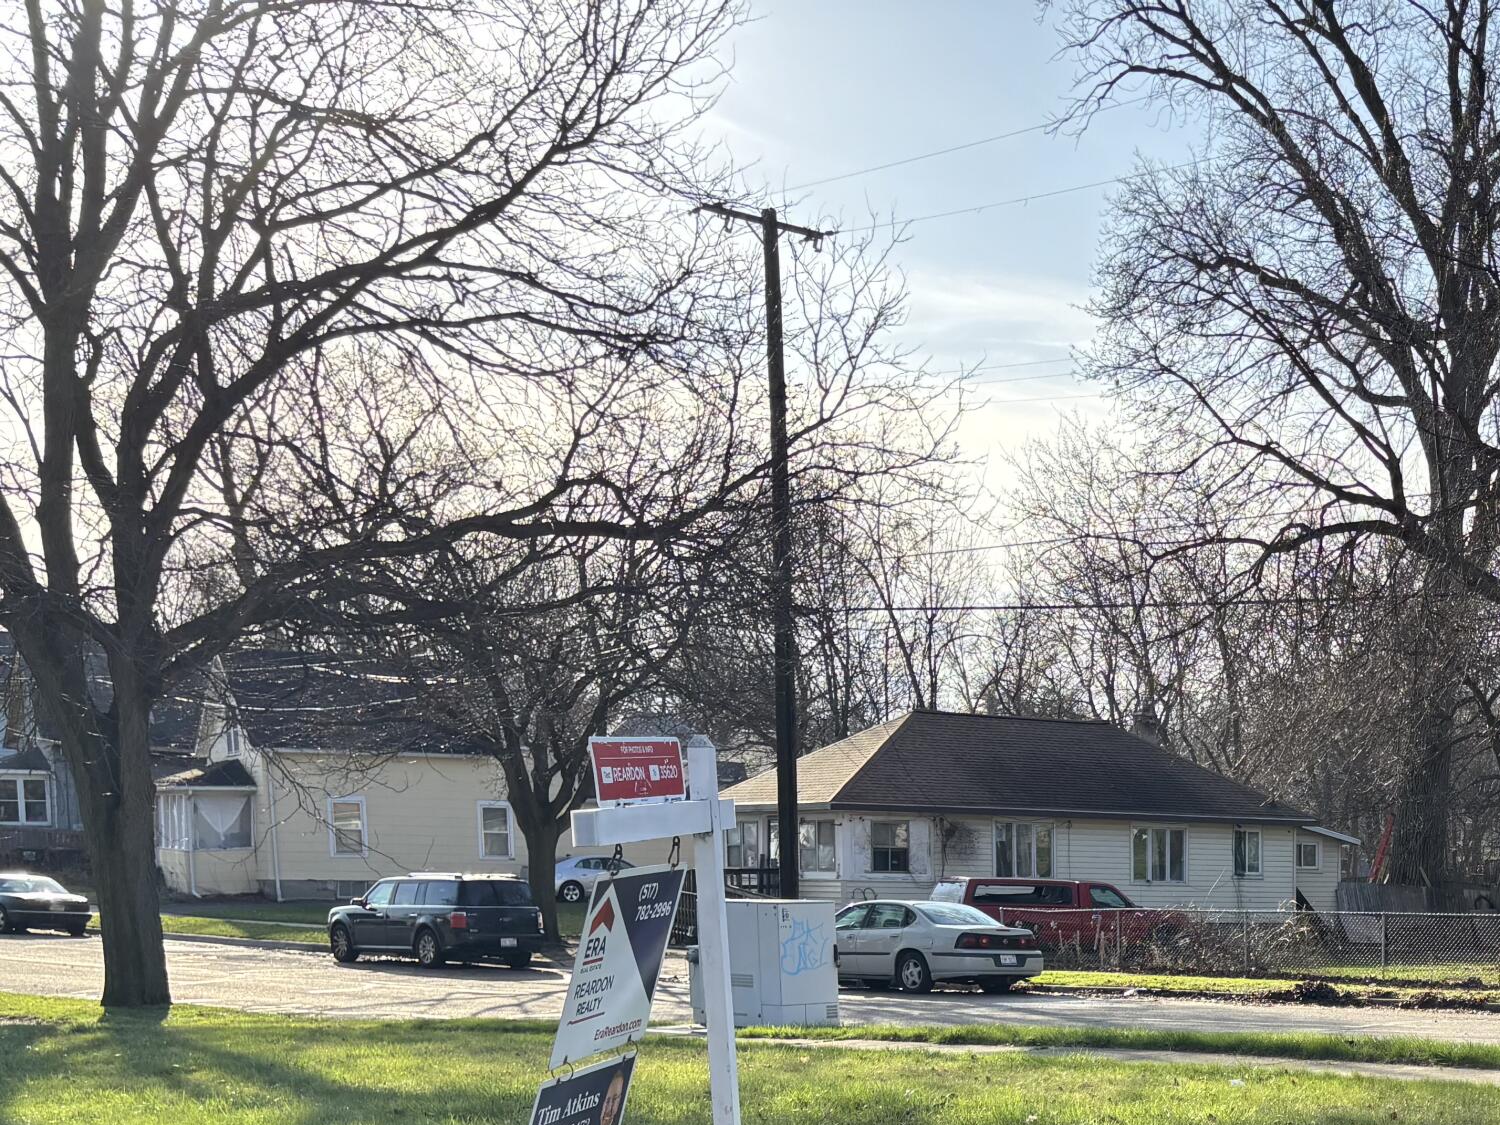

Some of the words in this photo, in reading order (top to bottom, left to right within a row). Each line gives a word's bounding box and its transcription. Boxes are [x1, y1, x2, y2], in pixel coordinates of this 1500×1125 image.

[613, 767, 646, 781] REARDON
[638, 882, 658, 902] (517)
[635, 901, 672, 921] 782-2996
[584, 936, 606, 959] ERA
[574, 975, 614, 1000] REARDON
[576, 997, 603, 1016] REALTY
[594, 1018, 642, 1040] EraReardon.com
[562, 1091, 600, 1119] Atkins
